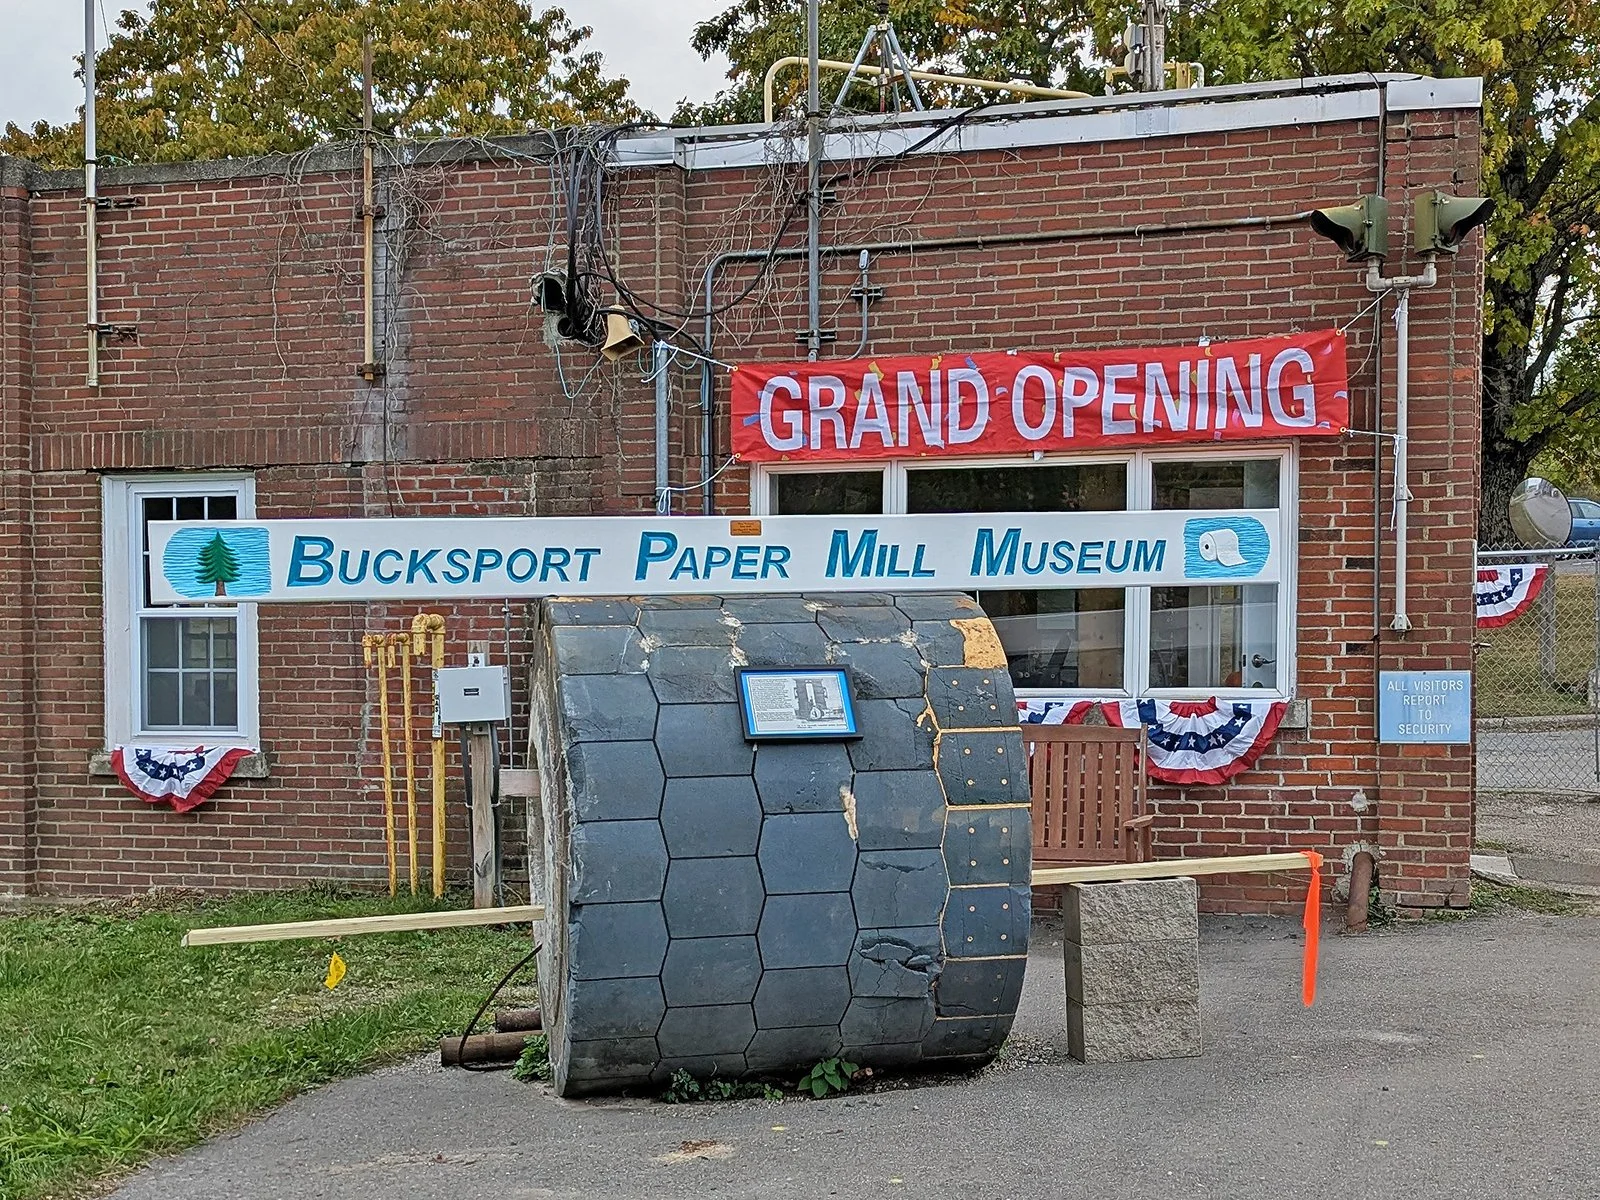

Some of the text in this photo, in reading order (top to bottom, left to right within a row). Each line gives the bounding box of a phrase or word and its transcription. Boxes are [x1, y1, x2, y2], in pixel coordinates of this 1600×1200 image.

[759, 347, 1317, 451] GRAND OPENING
[286, 527, 1167, 588] BUCKSPORT PAPER MILL MUSEUM
[1387, 680, 1464, 692] ALL VISITORS
[1403, 694, 1447, 706] REPORT
[1418, 709, 1432, 721] TO
[1398, 723, 1452, 735] SECURITY
